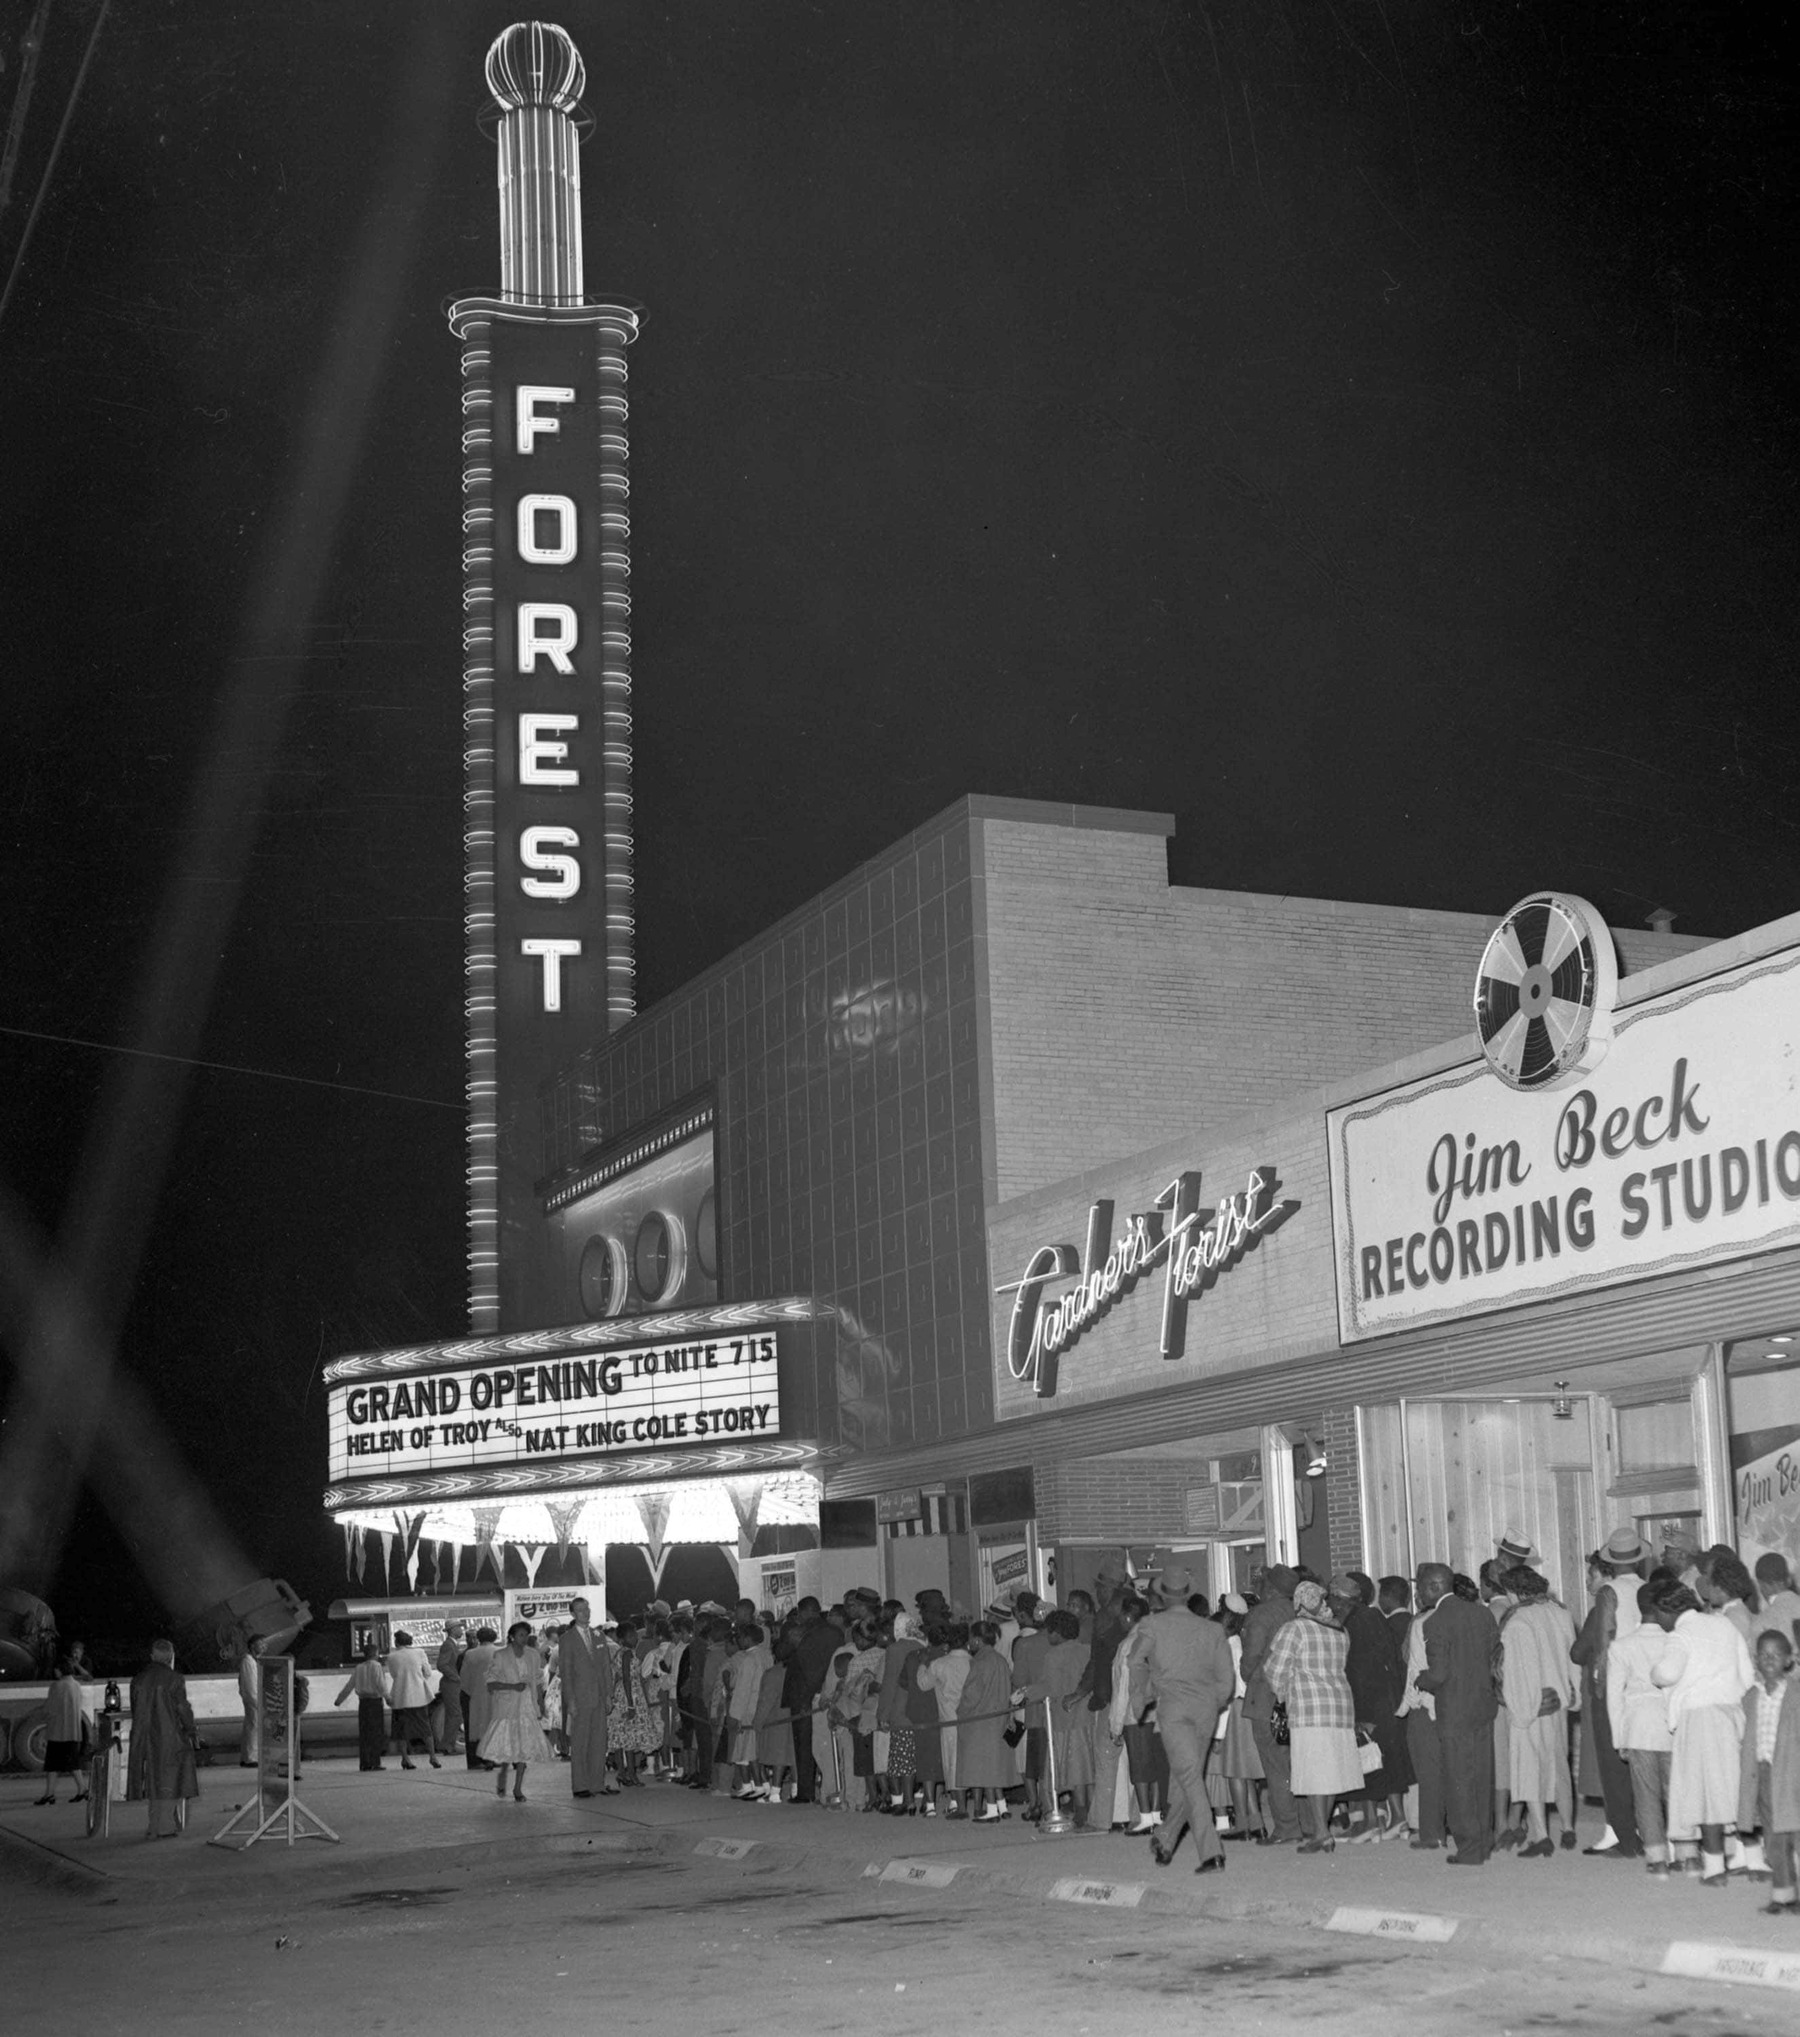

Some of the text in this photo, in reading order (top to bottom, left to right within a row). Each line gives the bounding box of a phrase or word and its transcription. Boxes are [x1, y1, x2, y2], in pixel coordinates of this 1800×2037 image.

[517, 386, 581, 1011] FOREST
[1361, 1130, 1800, 1303] RECORDING STUDIO
[1427, 1057, 1710, 1225] Jim Beck
[994, 1168, 1296, 1393] Gardner's Florist
[346, 1377, 460, 1425] GRAND
[470, 1356, 622, 1411] OPENING
[347, 1404, 770, 1456] HELEN OF TROY ALSO NAT KING COLE STORY
[1741, 1453, 1800, 1525] Jim Be
